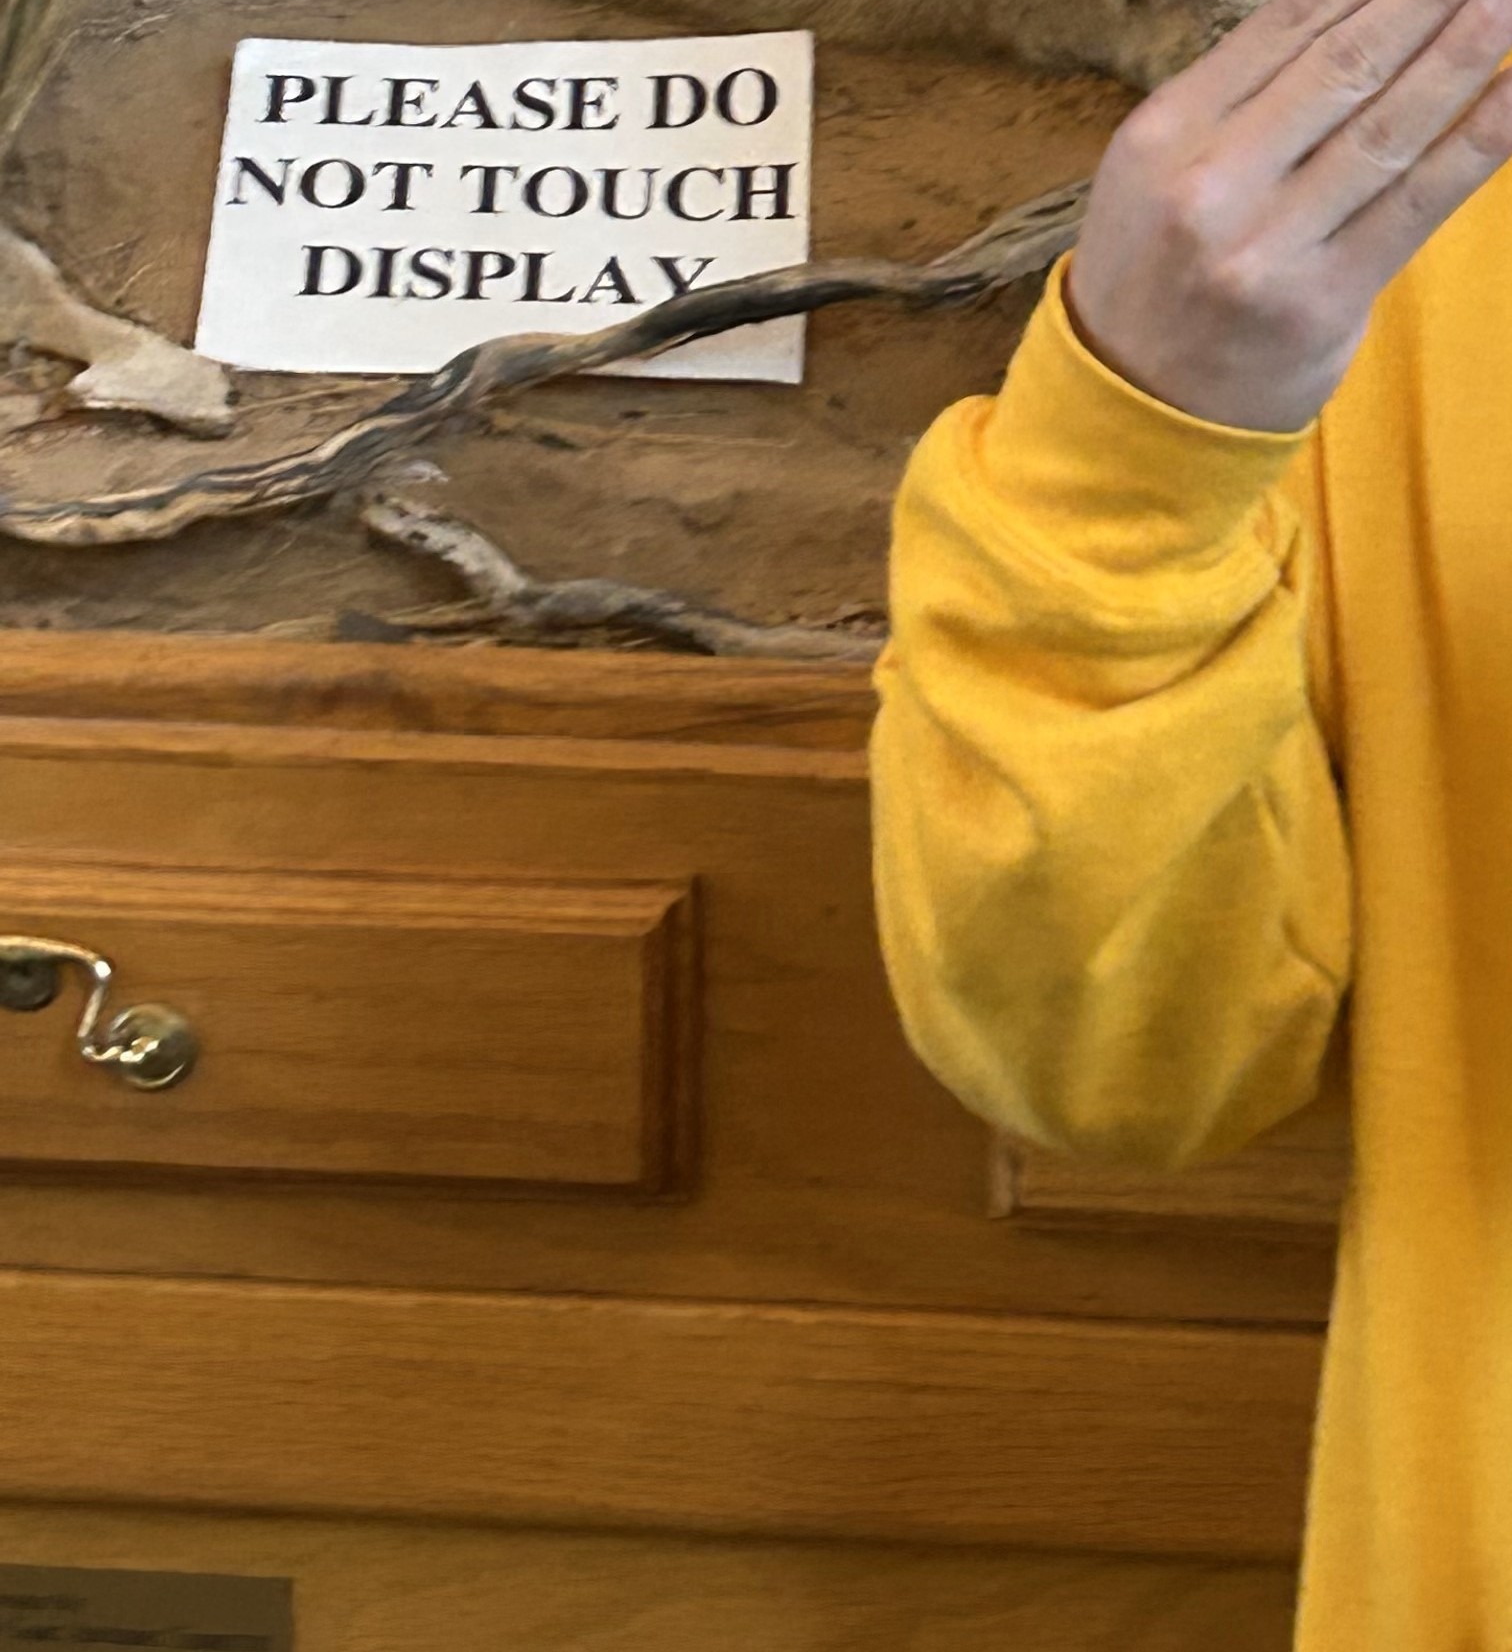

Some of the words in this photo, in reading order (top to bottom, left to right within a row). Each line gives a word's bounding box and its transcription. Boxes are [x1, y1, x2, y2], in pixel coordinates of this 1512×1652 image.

[254, 74, 620, 131] PLEASE
[646, 67, 779, 130] DO
[225, 158, 434, 212] NOT
[460, 162, 801, 221] TOUCH
[297, 245, 720, 305] DISPLAY
